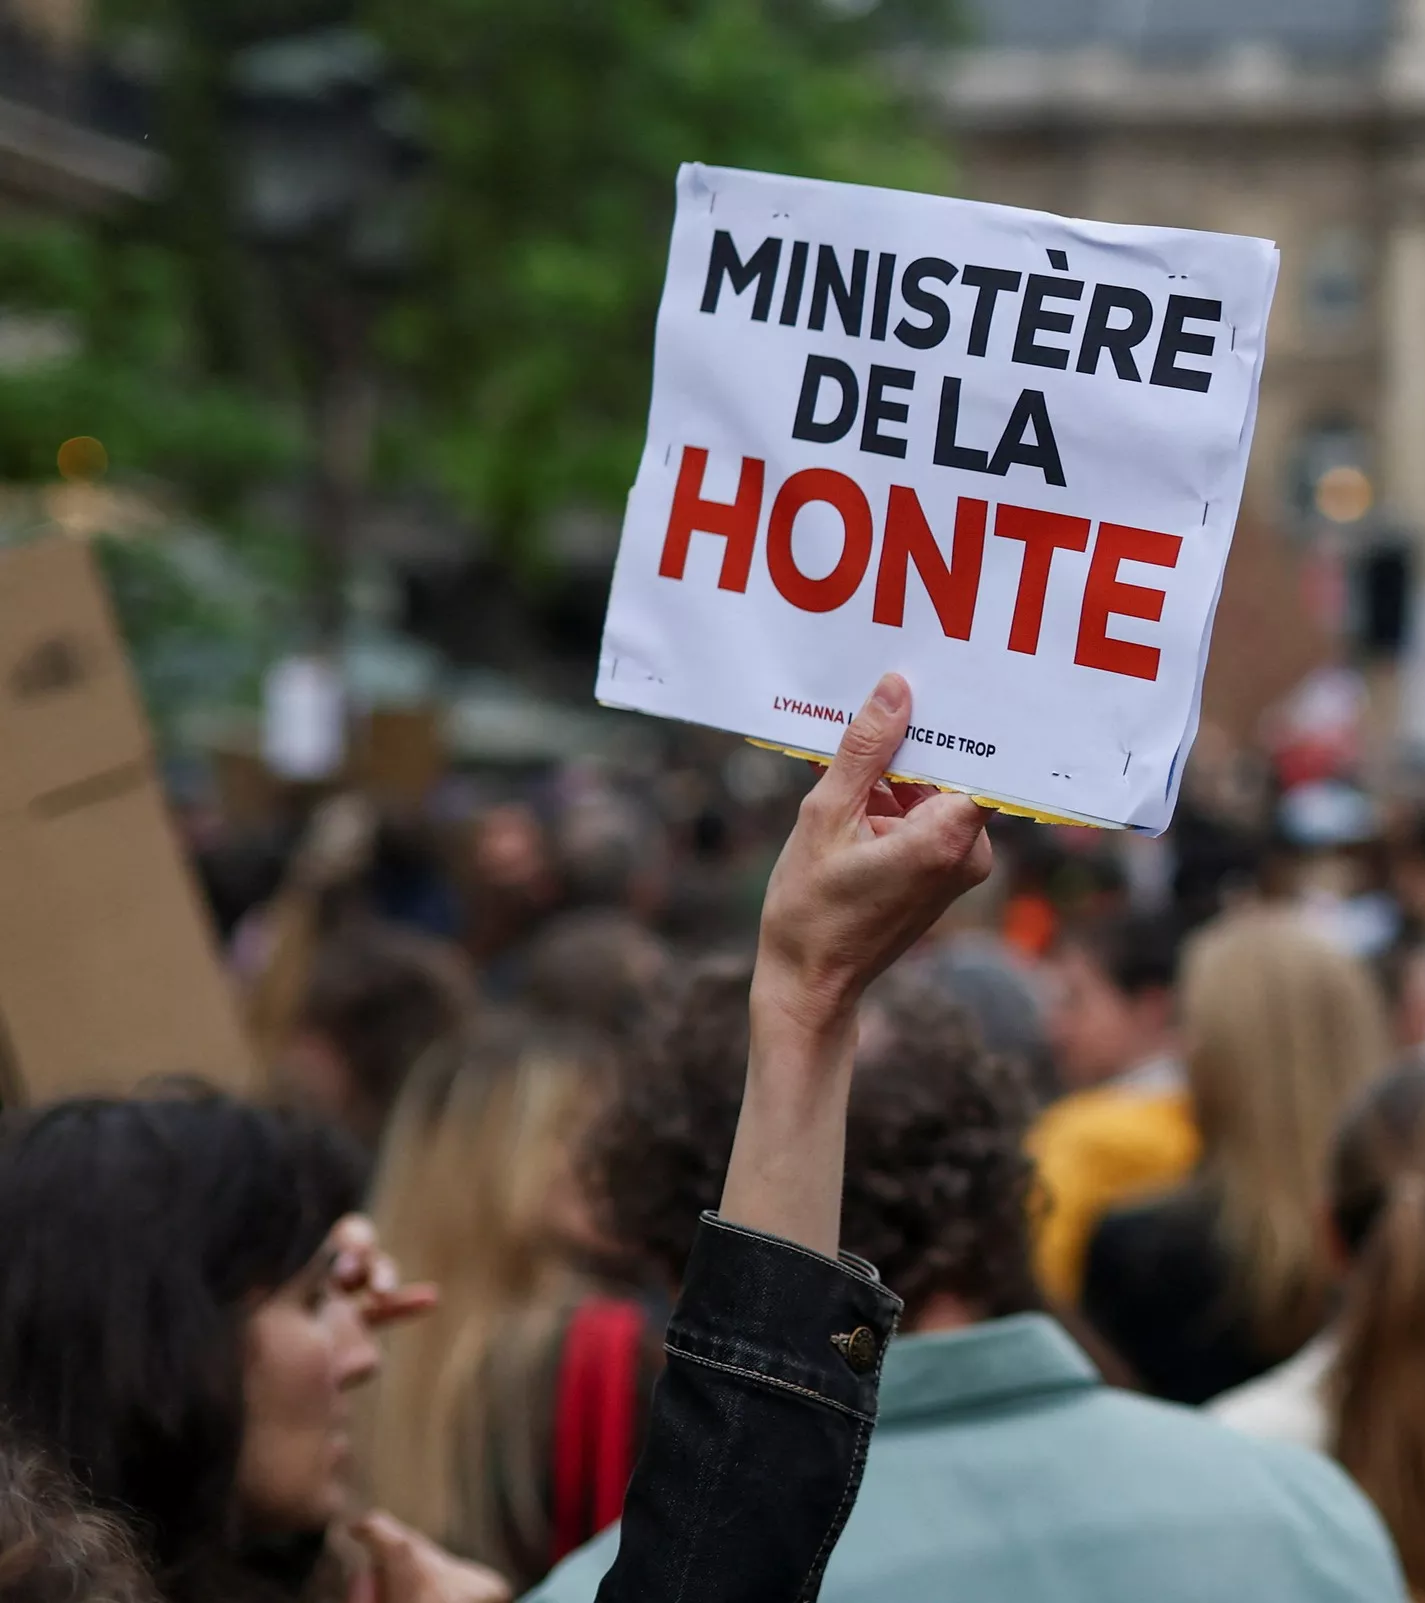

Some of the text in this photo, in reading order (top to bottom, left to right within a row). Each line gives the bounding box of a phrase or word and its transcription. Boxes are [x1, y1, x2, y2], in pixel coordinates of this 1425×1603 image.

[700, 230, 1222, 393] MINISTÈRE
[792, 354, 1067, 487] DE LA
[658, 446, 1184, 682] HONTE
[773, 696, 844, 724] LYHANNA
[936, 732, 956, 750] DE
[958, 737, 996, 758] TROP
